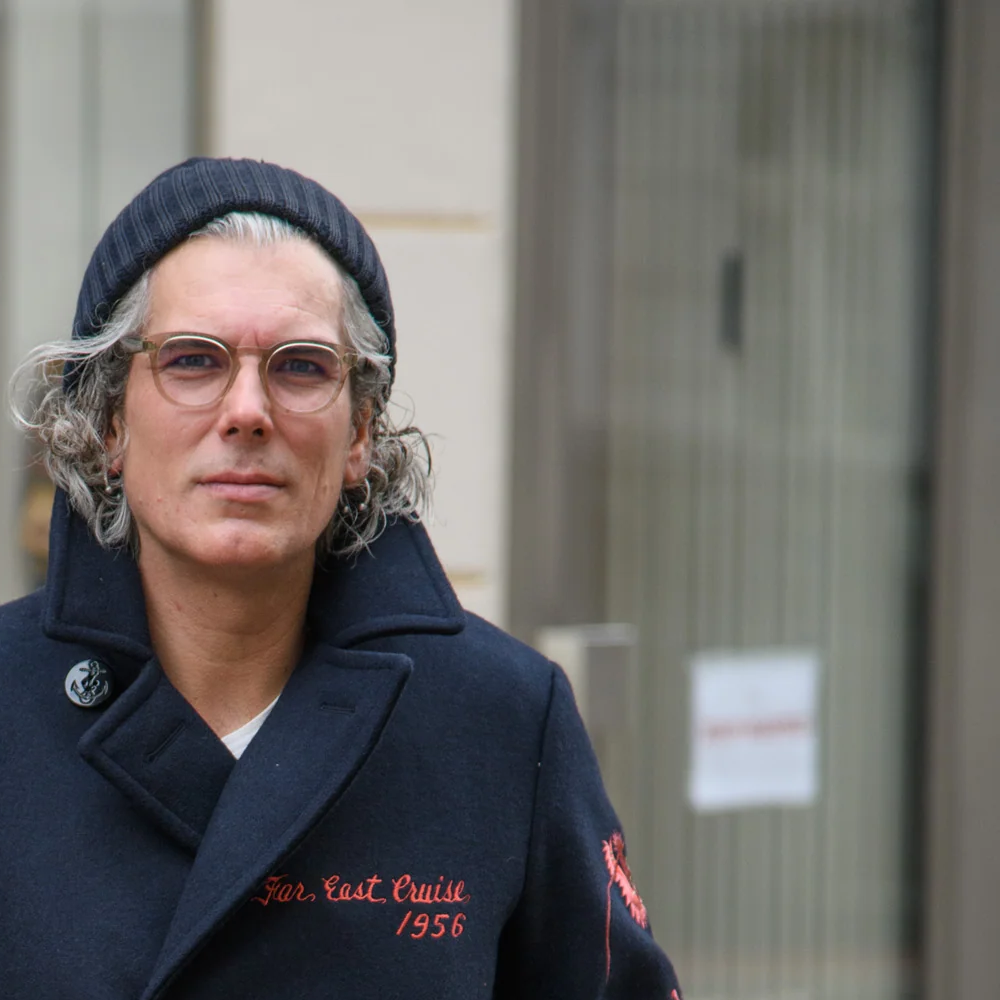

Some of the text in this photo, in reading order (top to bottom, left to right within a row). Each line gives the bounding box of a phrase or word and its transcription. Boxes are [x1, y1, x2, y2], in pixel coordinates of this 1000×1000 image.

[251, 873, 471, 906] Far East Cruise
[396, 910, 467, 939] 1956
